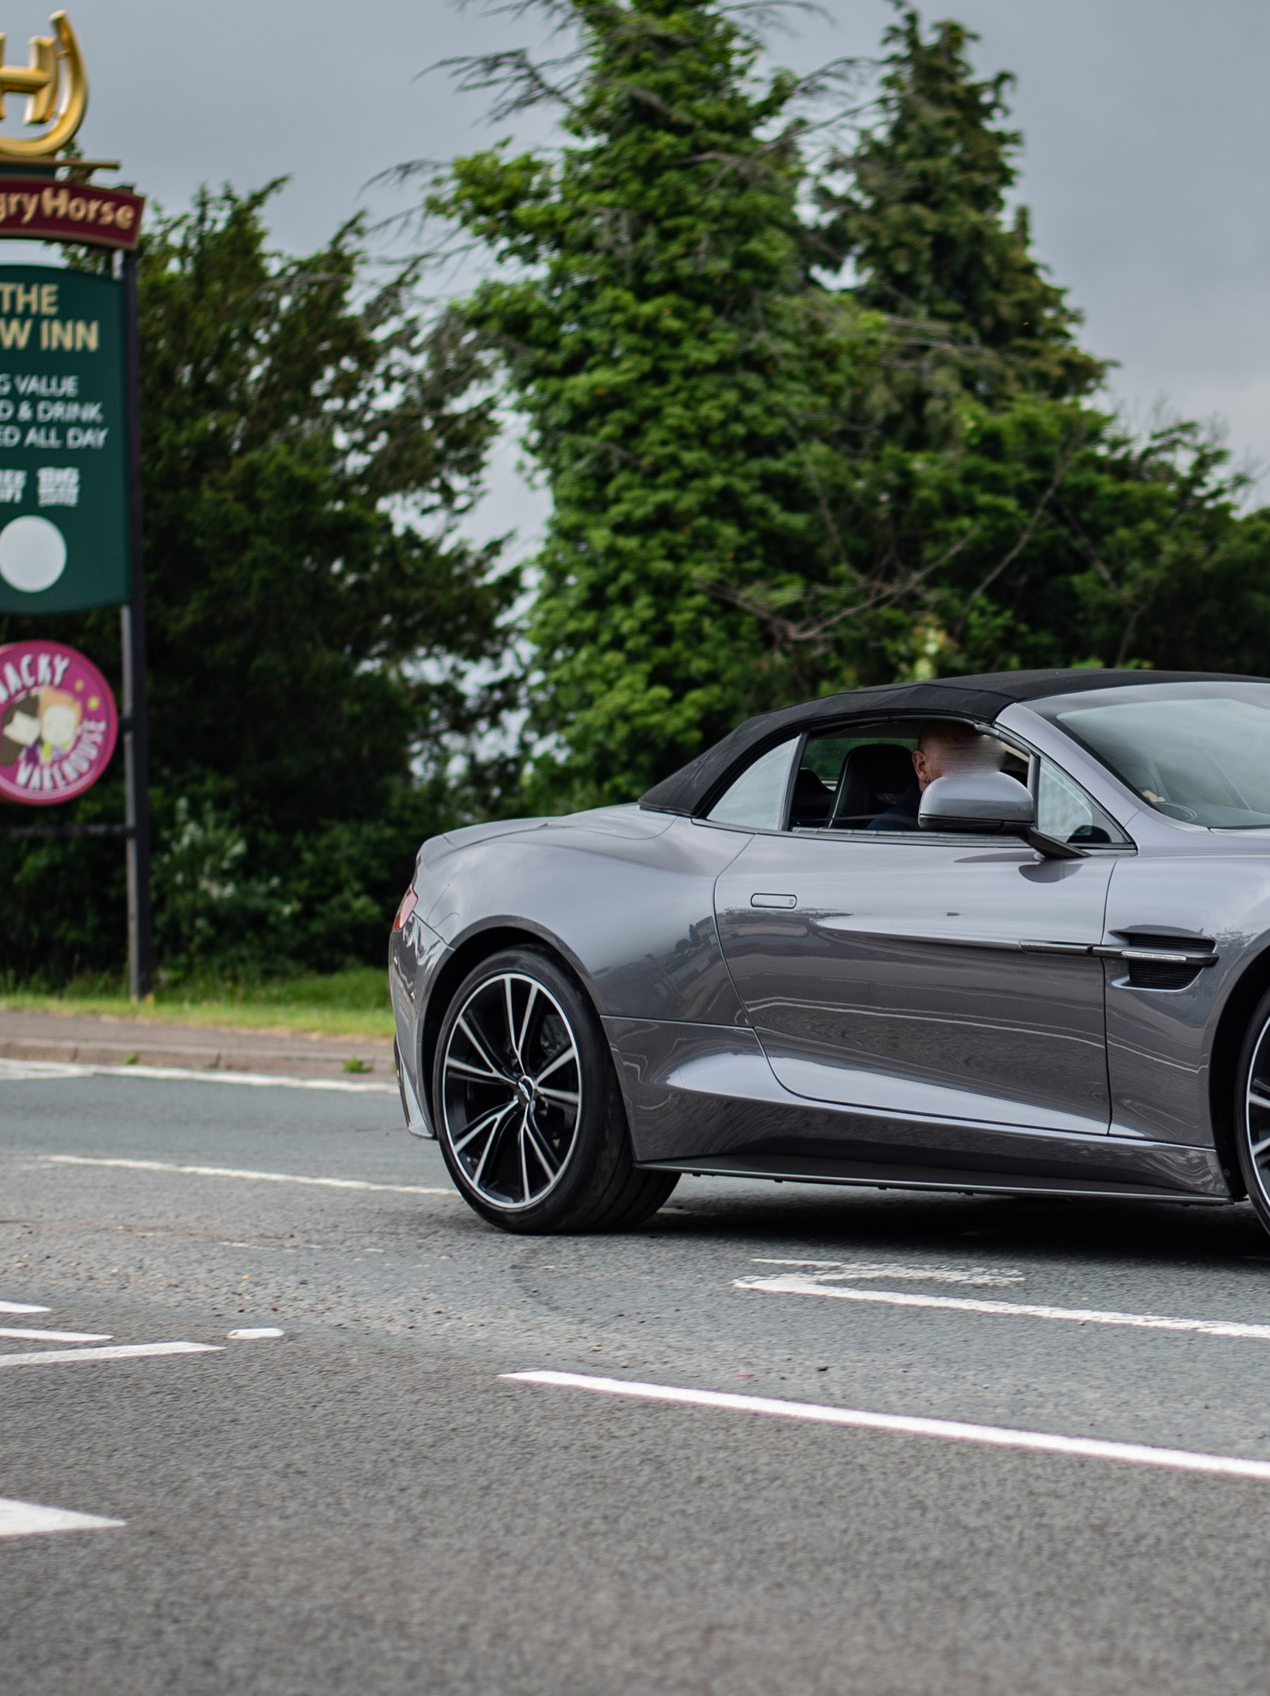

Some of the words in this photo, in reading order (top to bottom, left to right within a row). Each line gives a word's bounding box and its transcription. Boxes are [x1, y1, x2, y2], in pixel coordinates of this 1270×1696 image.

[0, 282, 59, 316] THE
[41, 319, 98, 352] INN
[14, 374, 79, 398] VALUE
[17, 400, 33, 422] &
[36, 400, 104, 424] DRINK
[23, 425, 62, 449] ALL
[66, 426, 109, 450] DAY
